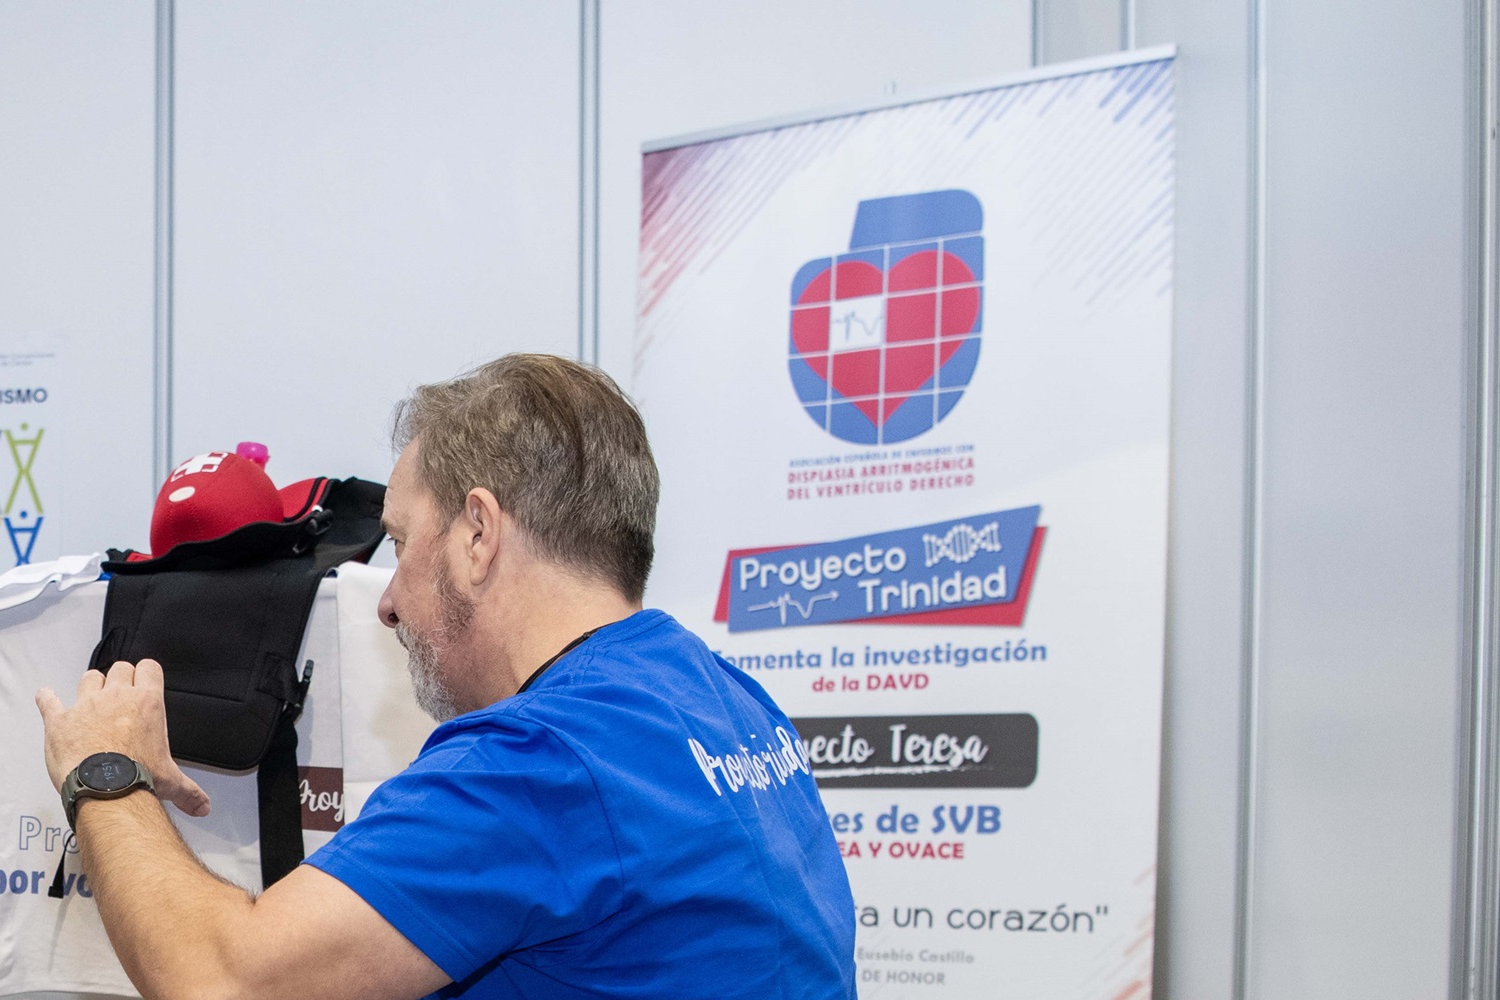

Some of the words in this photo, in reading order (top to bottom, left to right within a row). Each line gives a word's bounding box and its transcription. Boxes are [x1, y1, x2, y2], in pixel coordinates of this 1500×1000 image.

[787, 466, 855, 485] DISPLASIA
[860, 456, 975, 479] ARRITMOGÉNICA
[787, 487, 810, 501] DEL
[817, 479, 904, 499] VENTRÍCULO
[909, 473, 975, 492] DERECHO
[739, 544, 907, 592] Proyecto
[858, 566, 1007, 614] Trinidad
[831, 645, 855, 668] la
[863, 638, 1049, 669] investigación
[811, 676, 836, 693] de
[842, 675, 860, 692] la
[866, 673, 930, 692] DAVD
[889, 723, 989, 768] Teresa
[876, 805, 920, 834] de
[931, 805, 1002, 834] SVB
[868, 841, 882, 857] Y
[888, 841, 966, 859] OVACE
[893, 907, 934, 929] un
[946, 903, 1109, 933] corazón"
[861, 969, 881, 983] DE
[886, 969, 946, 985] HONOR
